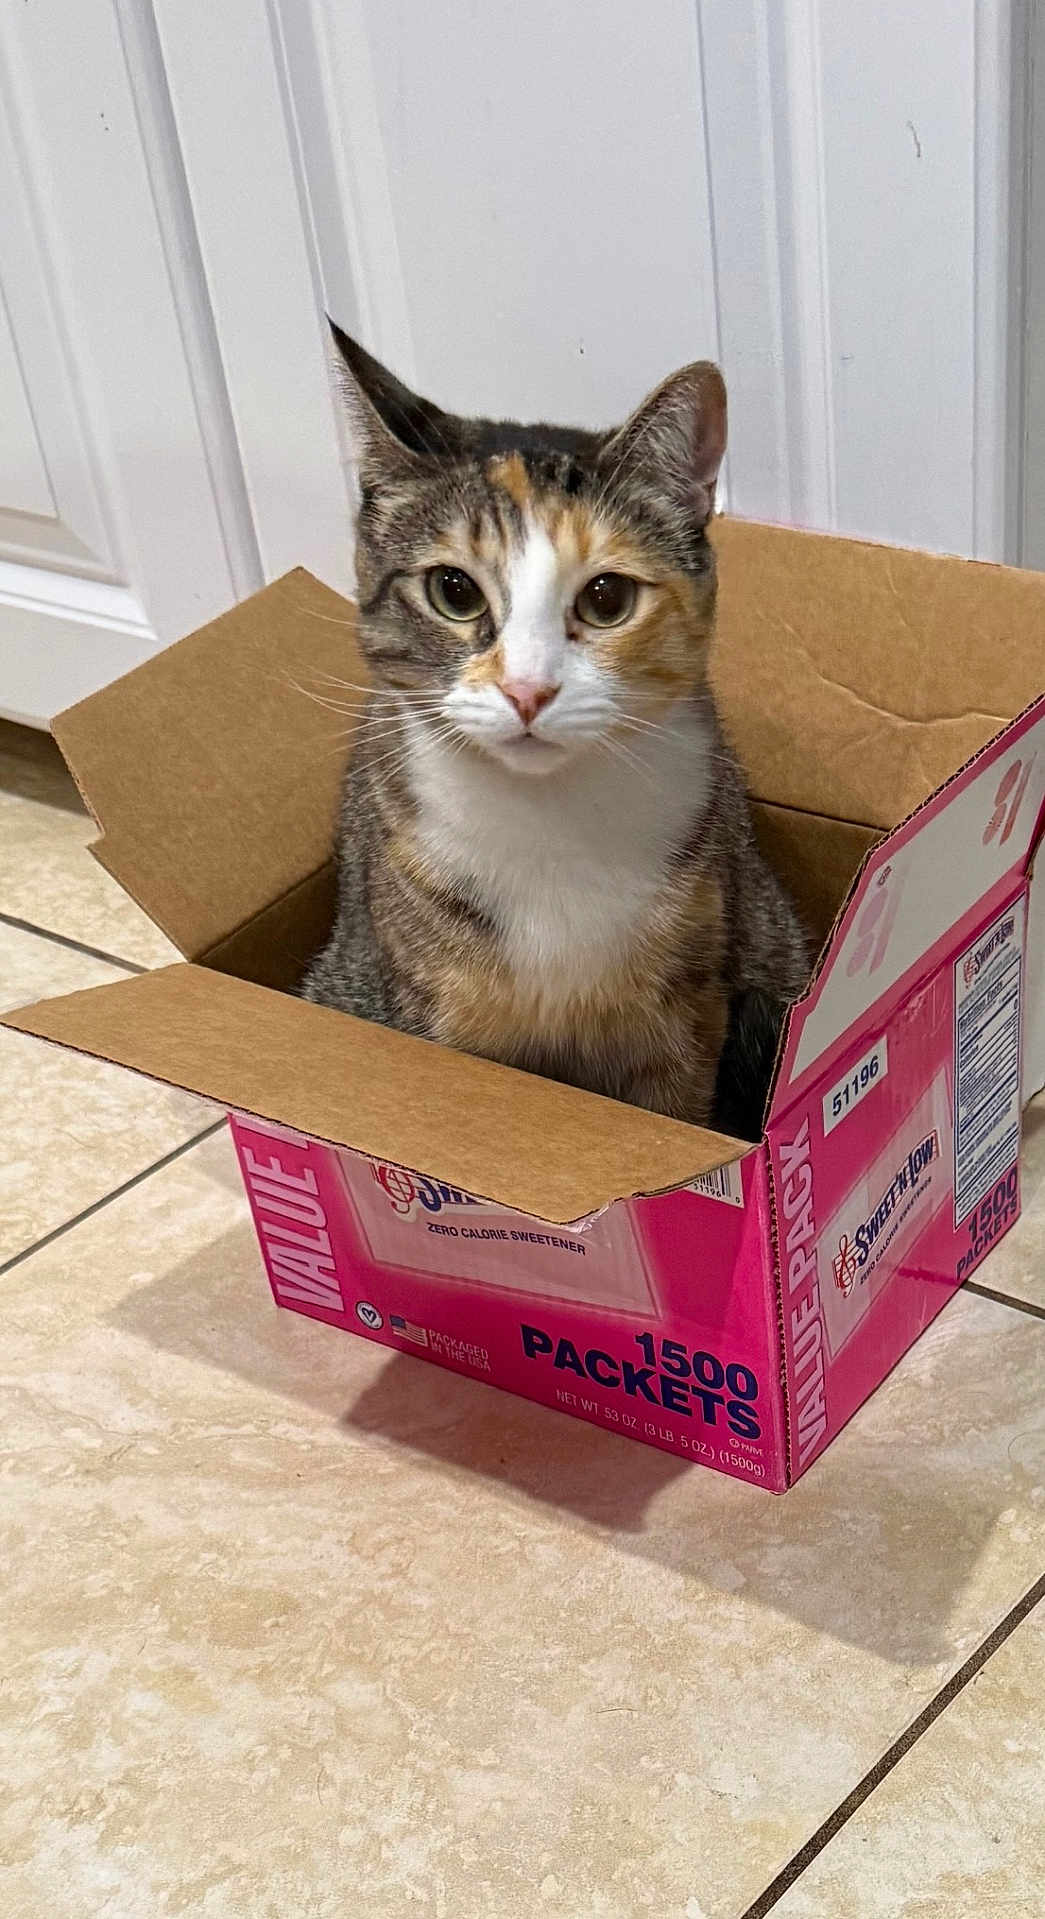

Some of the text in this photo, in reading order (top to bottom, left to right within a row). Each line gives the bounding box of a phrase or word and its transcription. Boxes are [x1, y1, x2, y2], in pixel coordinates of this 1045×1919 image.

[832, 1055, 879, 1117] 51196
[241, 1147, 345, 1313] VALUE
[427, 1221, 586, 1256] ZERO CALORIE SWEETENER
[956, 1192, 1018, 1281] PACKETS
[968, 1165, 1018, 1243] 1500
[779, 1116, 828, 1469] VALUE PACK
[428, 1328, 490, 1360] PACKAGED
[445, 1347, 465, 1362] THE
[467, 1355, 492, 1372] USA
[520, 1323, 763, 1441] PACKETS
[634, 1331, 760, 1402] 1500
[556, 1389, 577, 1408] NET
[604, 1407, 620, 1422] 53
[680, 1435, 689, 1448] 5
[719, 1449, 766, 1478] (1500g)
